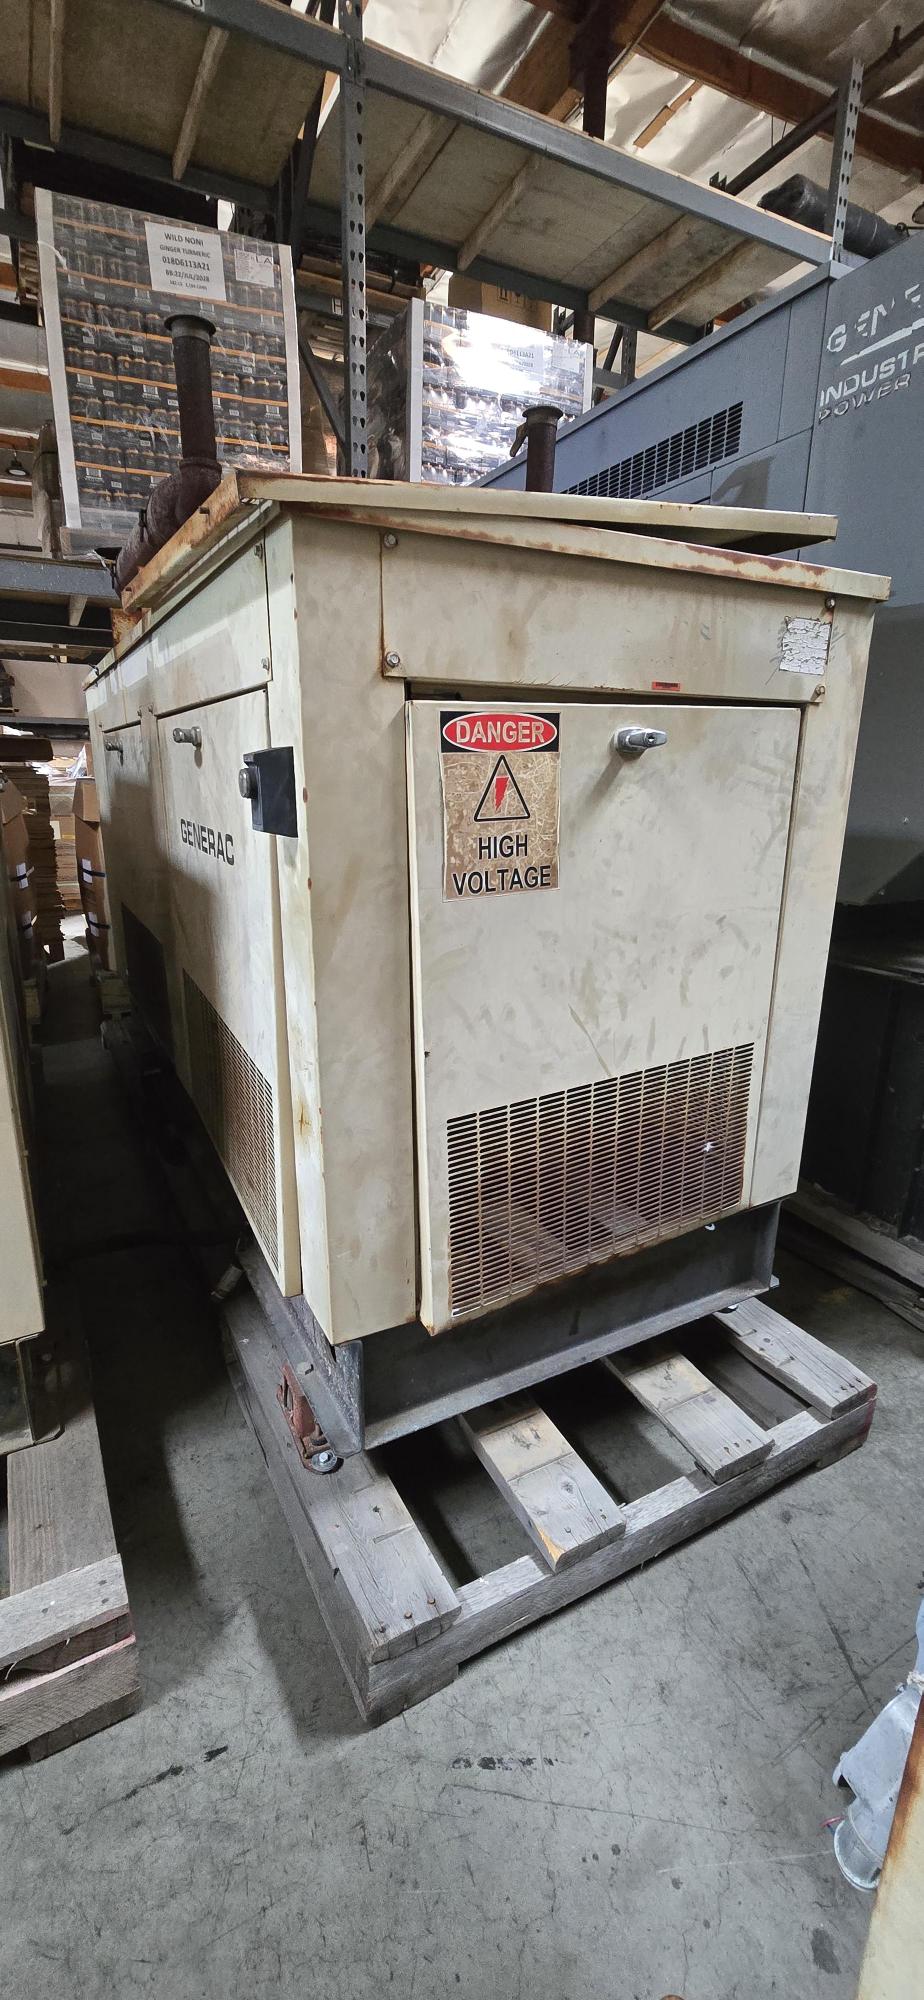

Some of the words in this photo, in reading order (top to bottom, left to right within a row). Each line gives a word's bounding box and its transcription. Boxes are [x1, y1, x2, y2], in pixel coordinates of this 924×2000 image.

[160, 244, 181, 255] GINGER
[182, 247, 211, 259] TURMERIC
[164, 232, 183, 243] WILD
[185, 236, 204, 247] NONI
[456, 720, 545, 744] DANGER
[180, 818, 235, 866] GENERAC
[478, 834, 528, 860] HIGH
[452, 865, 551, 896] VOLTAGE
